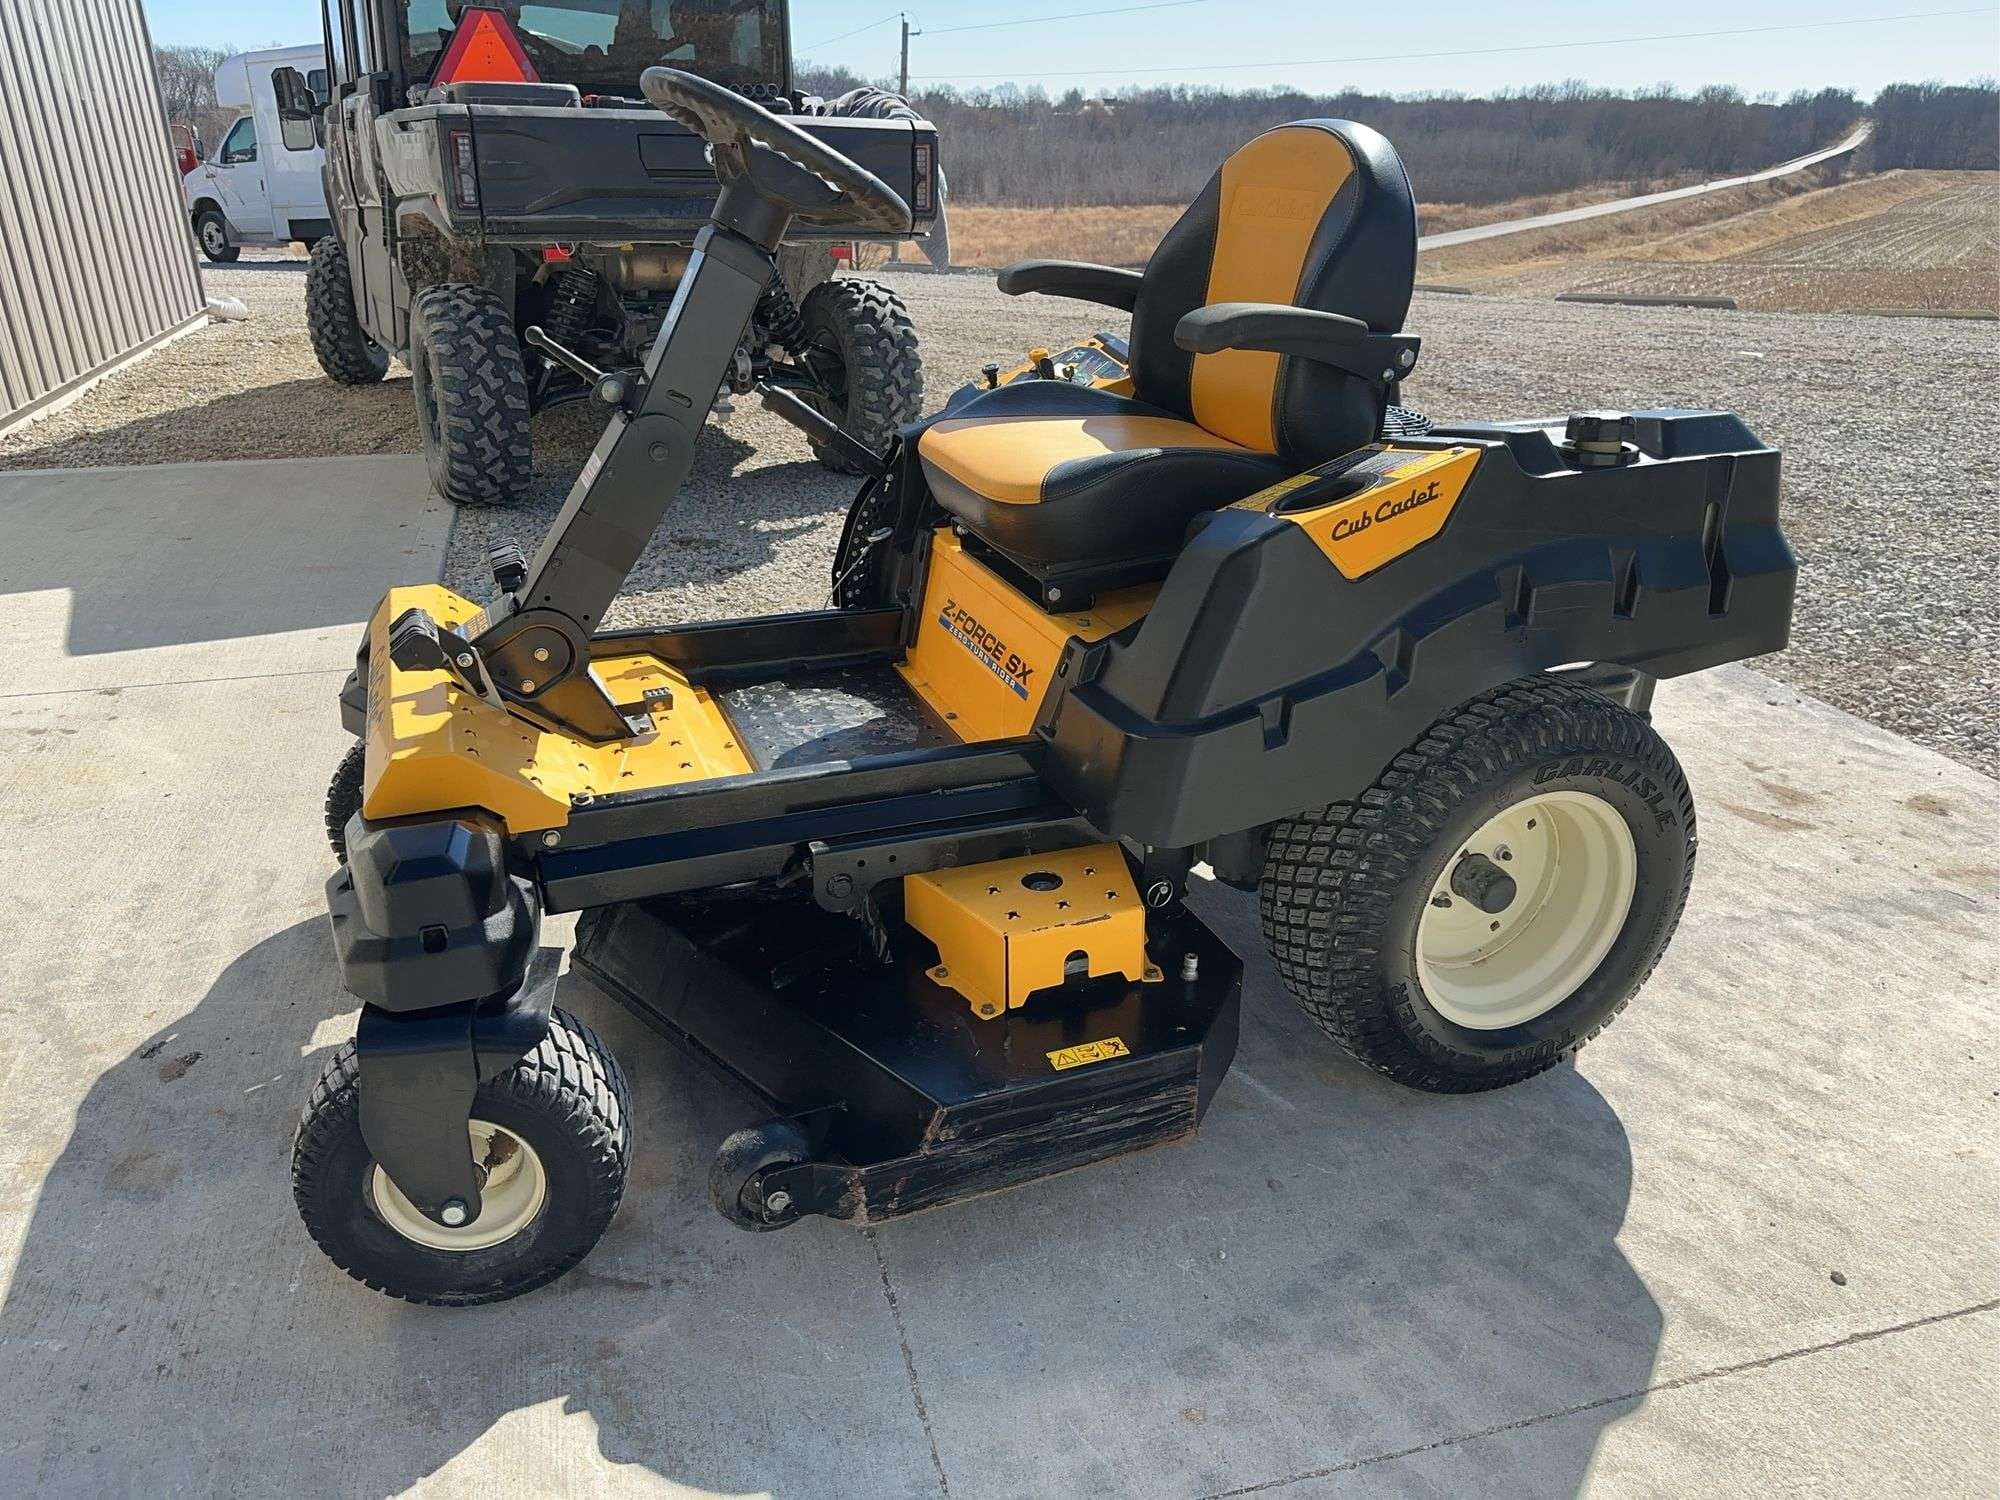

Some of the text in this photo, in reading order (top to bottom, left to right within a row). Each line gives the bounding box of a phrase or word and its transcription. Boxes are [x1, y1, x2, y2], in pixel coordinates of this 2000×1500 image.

[1332, 481, 1440, 541] Cub Cadet
[992, 663, 1016, 689] RIDER
[1005, 654, 1034, 686] SX
[1535, 758, 1677, 833] CARLISLE
